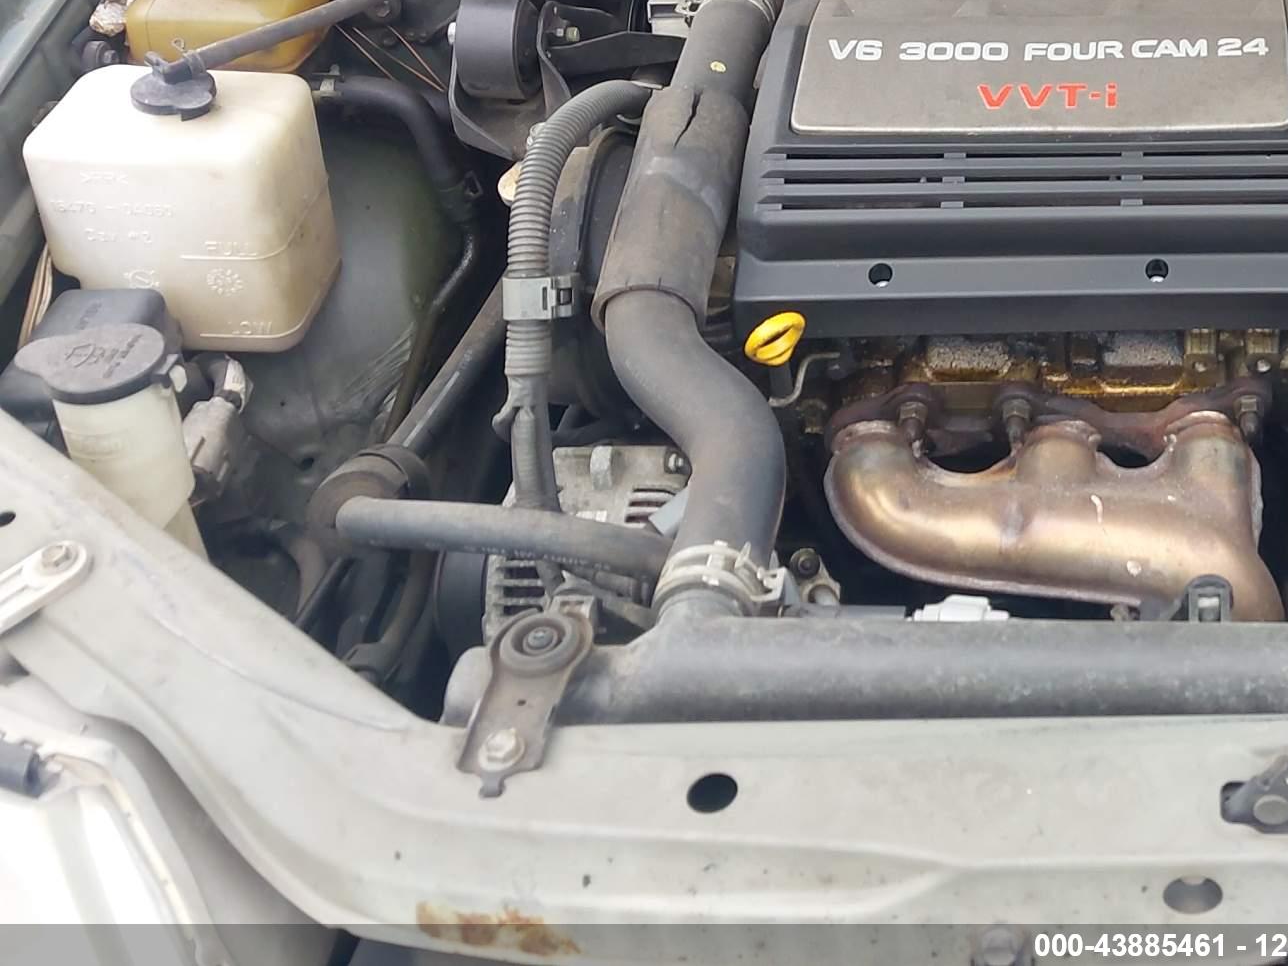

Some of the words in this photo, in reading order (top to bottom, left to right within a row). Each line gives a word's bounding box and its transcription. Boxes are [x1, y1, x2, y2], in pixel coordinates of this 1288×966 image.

[828, 39, 883, 61] V6
[899, 41, 1009, 61] 3000
[1023, 41, 1125, 62] FOUR
[1131, 38, 1208, 59] CAM
[1217, 37, 1269, 57] 24
[977, 82, 1118, 110] VVT-i
[204, 241, 258, 256] FULL
[229, 320, 273, 335] LOW
